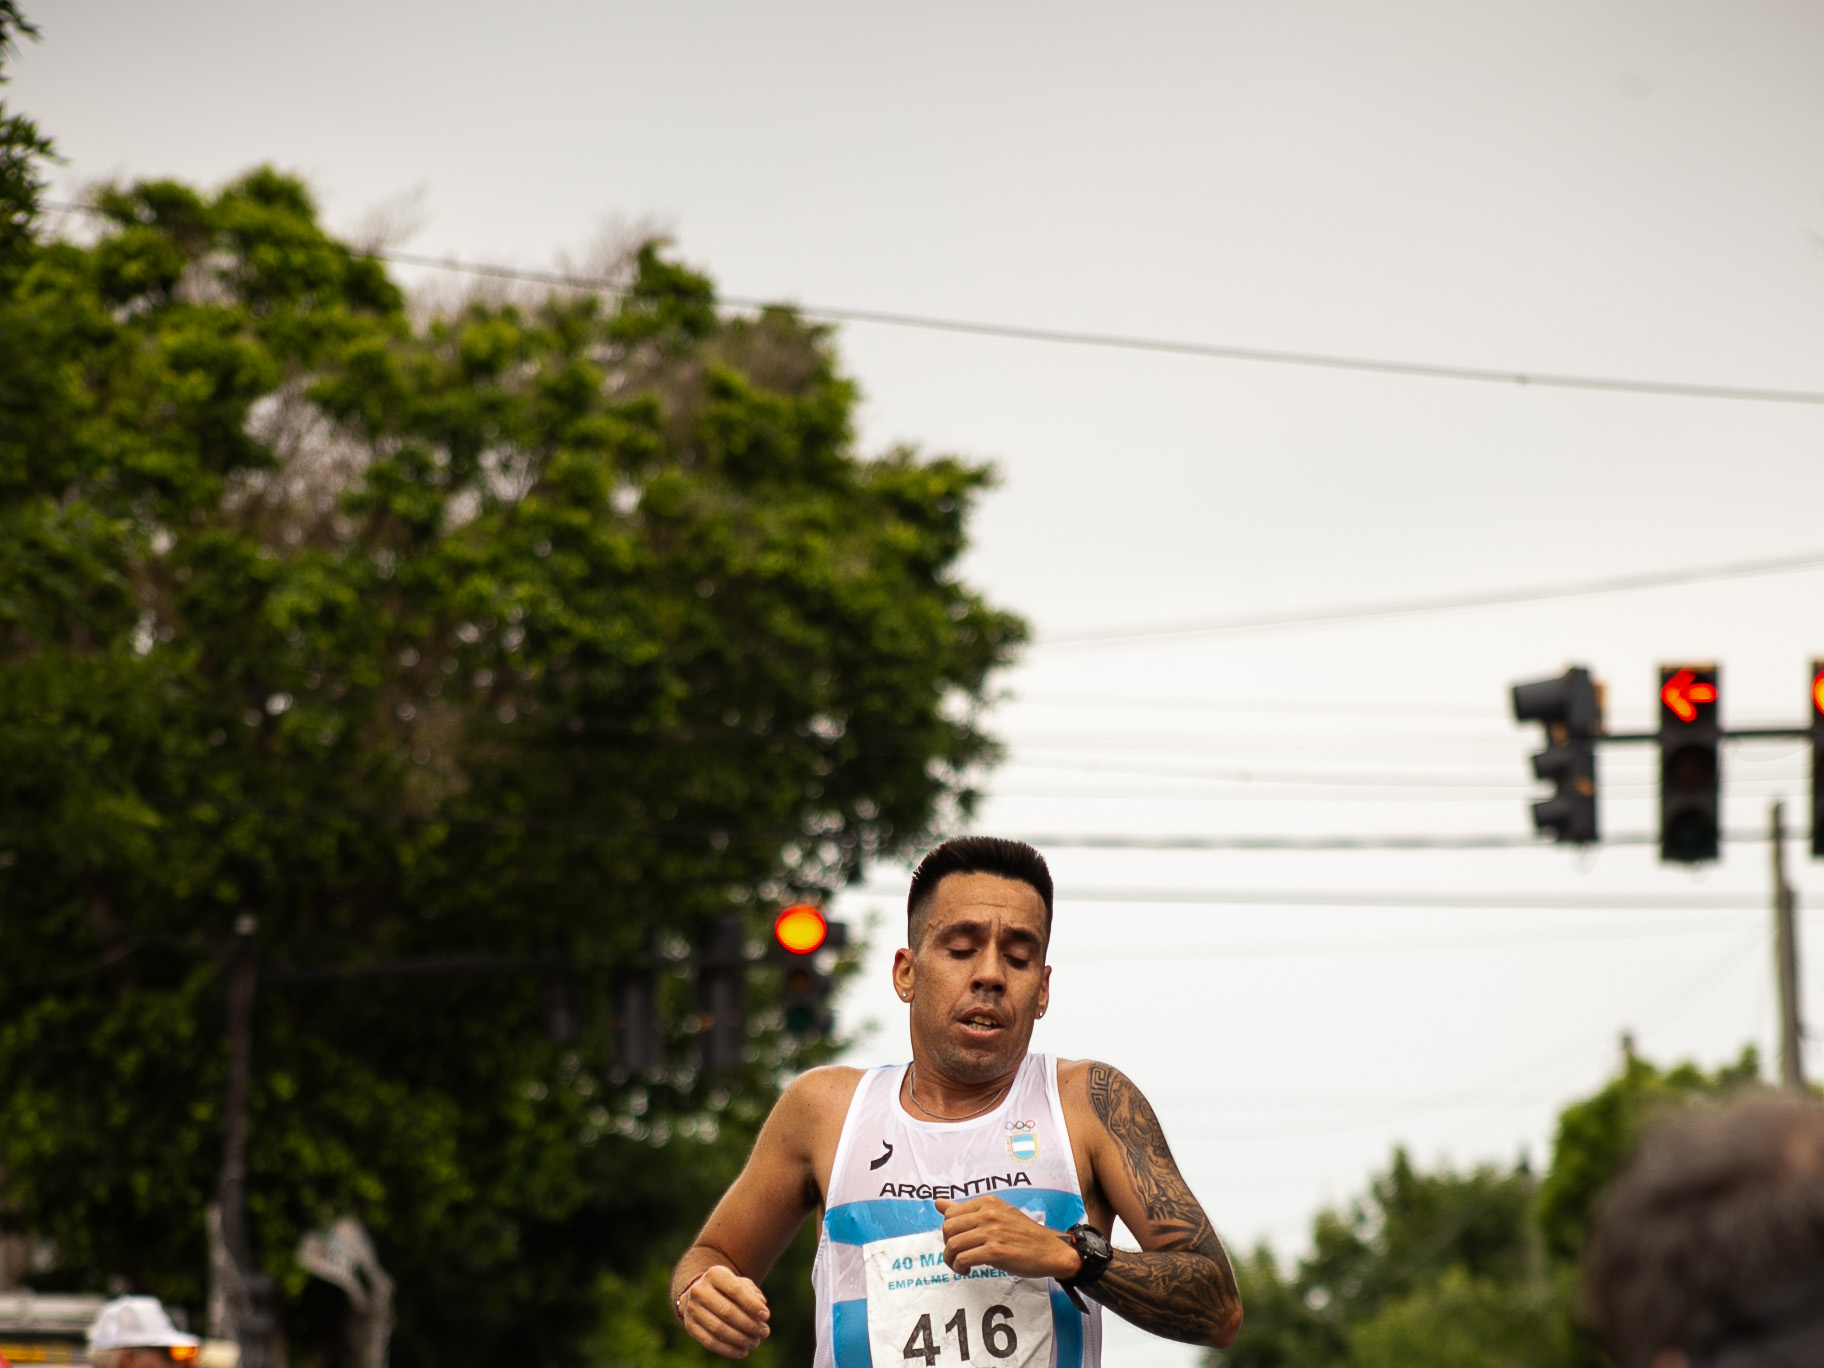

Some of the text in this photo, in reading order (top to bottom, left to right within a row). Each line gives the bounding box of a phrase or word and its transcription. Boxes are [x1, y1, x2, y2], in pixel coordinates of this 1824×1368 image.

[878, 1171, 1032, 1200] ARGENTINA
[892, 1256, 913, 1271] 40
[888, 1273, 950, 1291] EMPALME
[903, 1304, 1018, 1367] 416
